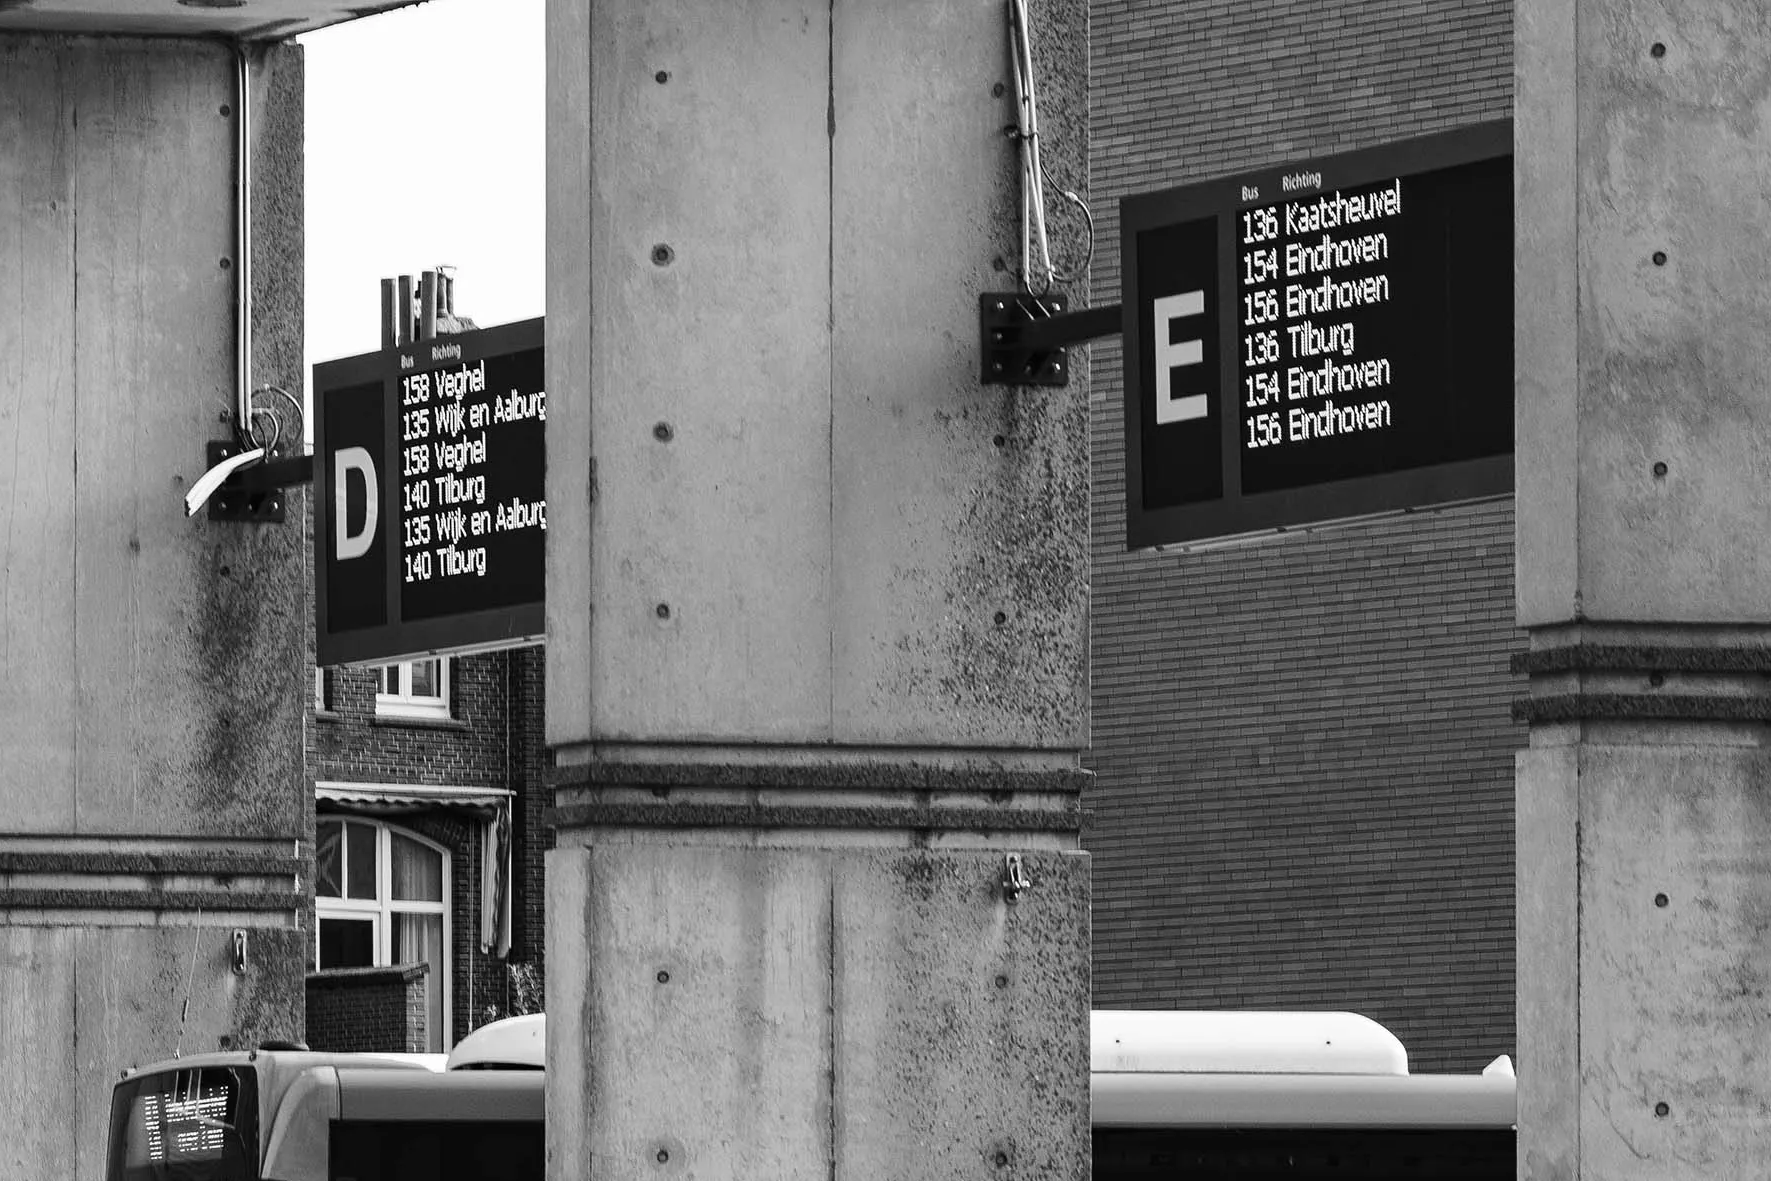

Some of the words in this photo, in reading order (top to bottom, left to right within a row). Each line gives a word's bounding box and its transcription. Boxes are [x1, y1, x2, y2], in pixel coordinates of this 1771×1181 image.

[1241, 185, 1259, 201] Bus
[1282, 170, 1322, 191] Richting
[1243, 207, 1279, 244] 136
[1285, 178, 1402, 236] Kaatsheuvel
[1244, 247, 1279, 285] 154
[1286, 233, 1389, 277] Eindhoven
[1244, 290, 1279, 326] 156
[1286, 274, 1390, 318] Eindhoven
[1154, 289, 1208, 425] E
[1244, 331, 1280, 367] 136
[1286, 321, 1356, 358] Tilburg
[402, 373, 429, 406] 158
[435, 359, 486, 400] Veghel
[1245, 371, 1280, 408] 154
[1287, 357, 1391, 401] Eindhoven
[403, 409, 430, 441] 135
[435, 401, 467, 438] Wijk
[469, 400, 490, 428] en
[1246, 412, 1282, 449] 156
[1288, 399, 1392, 442] Eindhoven
[403, 445, 430, 477] 158
[435, 431, 487, 473] Veghel
[334, 446, 379, 561] D
[403, 481, 430, 512] 140
[435, 473, 486, 505] Tilburg
[404, 516, 431, 548] 135
[435, 507, 467, 544] Wijk
[470, 508, 491, 535] en
[405, 552, 432, 583] 140
[436, 544, 487, 578] Tilburg
